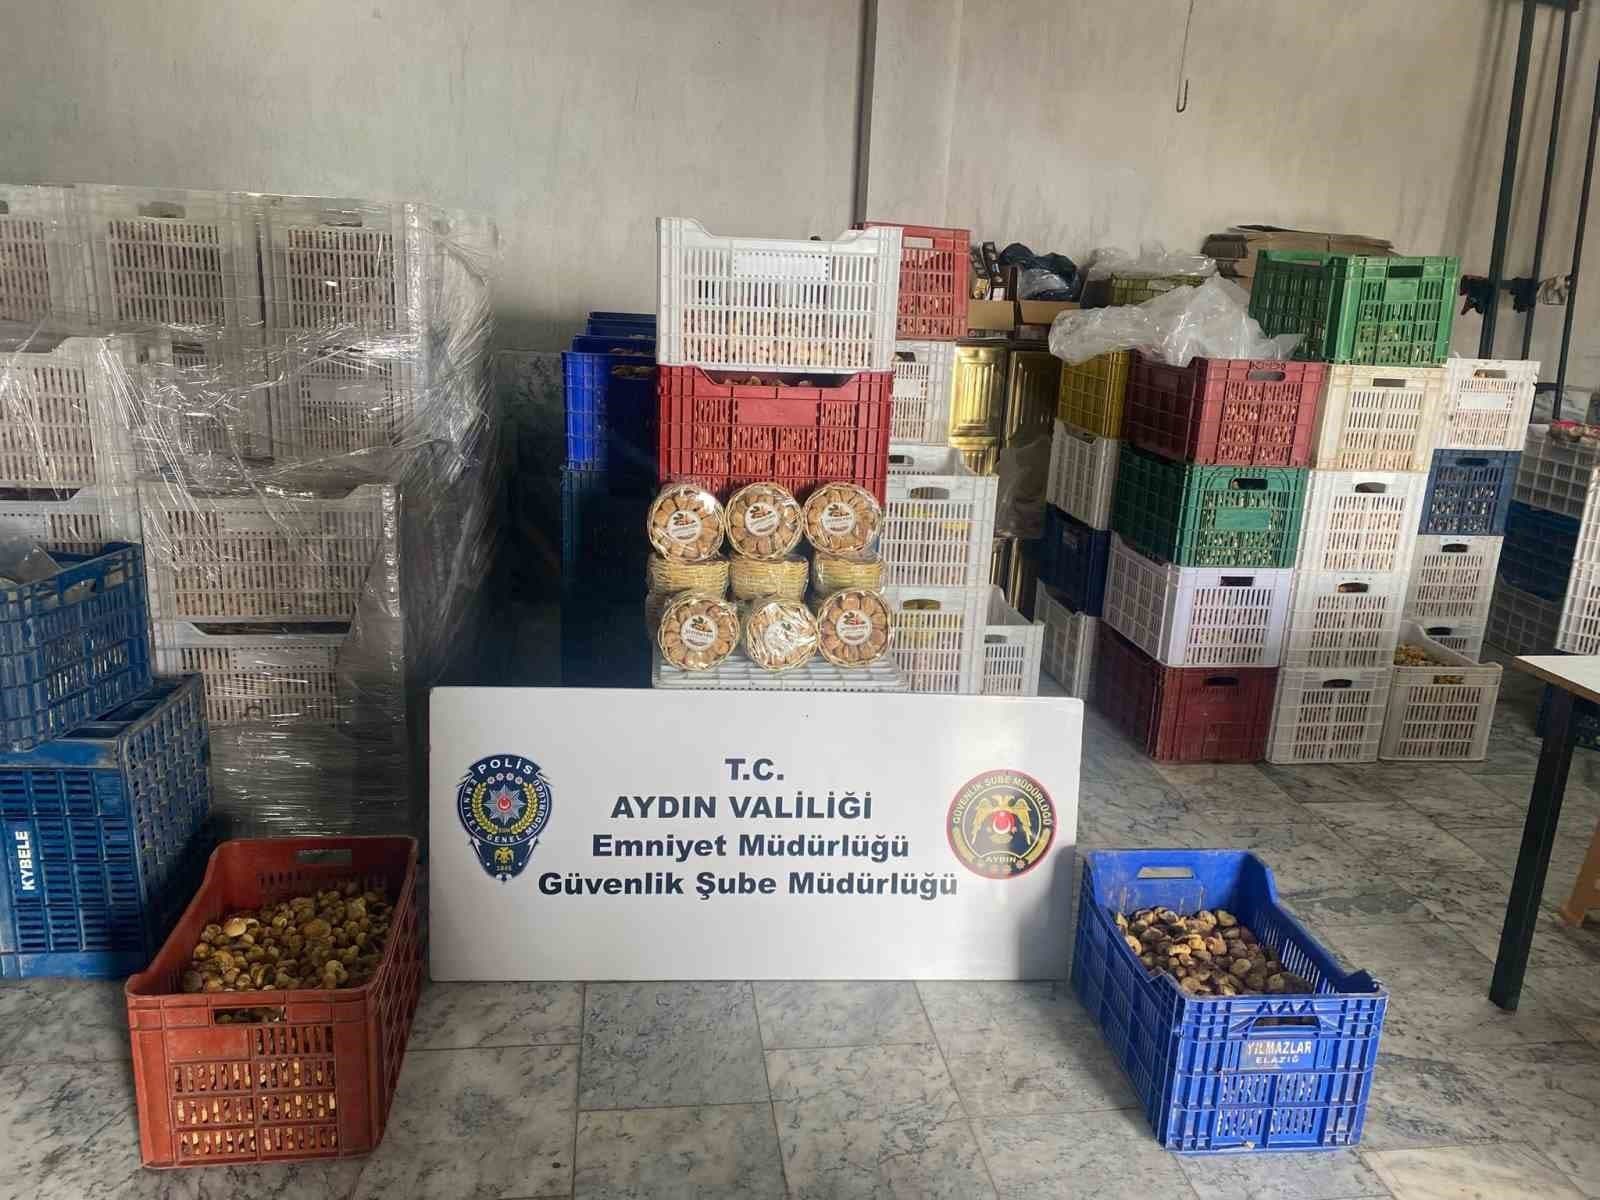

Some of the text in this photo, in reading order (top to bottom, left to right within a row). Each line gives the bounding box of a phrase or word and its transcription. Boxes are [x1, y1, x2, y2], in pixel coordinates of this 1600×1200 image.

[478, 758, 533, 775] POLİS
[725, 758, 785, 781] T.C.
[610, 790, 872, 819] AYDIN VALİLİĞİ
[486, 833, 521, 843] GENEL
[592, 834, 909, 862] Emniyet Müdürlüğü
[15, 831, 36, 890] KYBELE
[985, 856, 1017, 864] AYDIN
[538, 871, 958, 901] Güvenlik Şube Müdürlüğü
